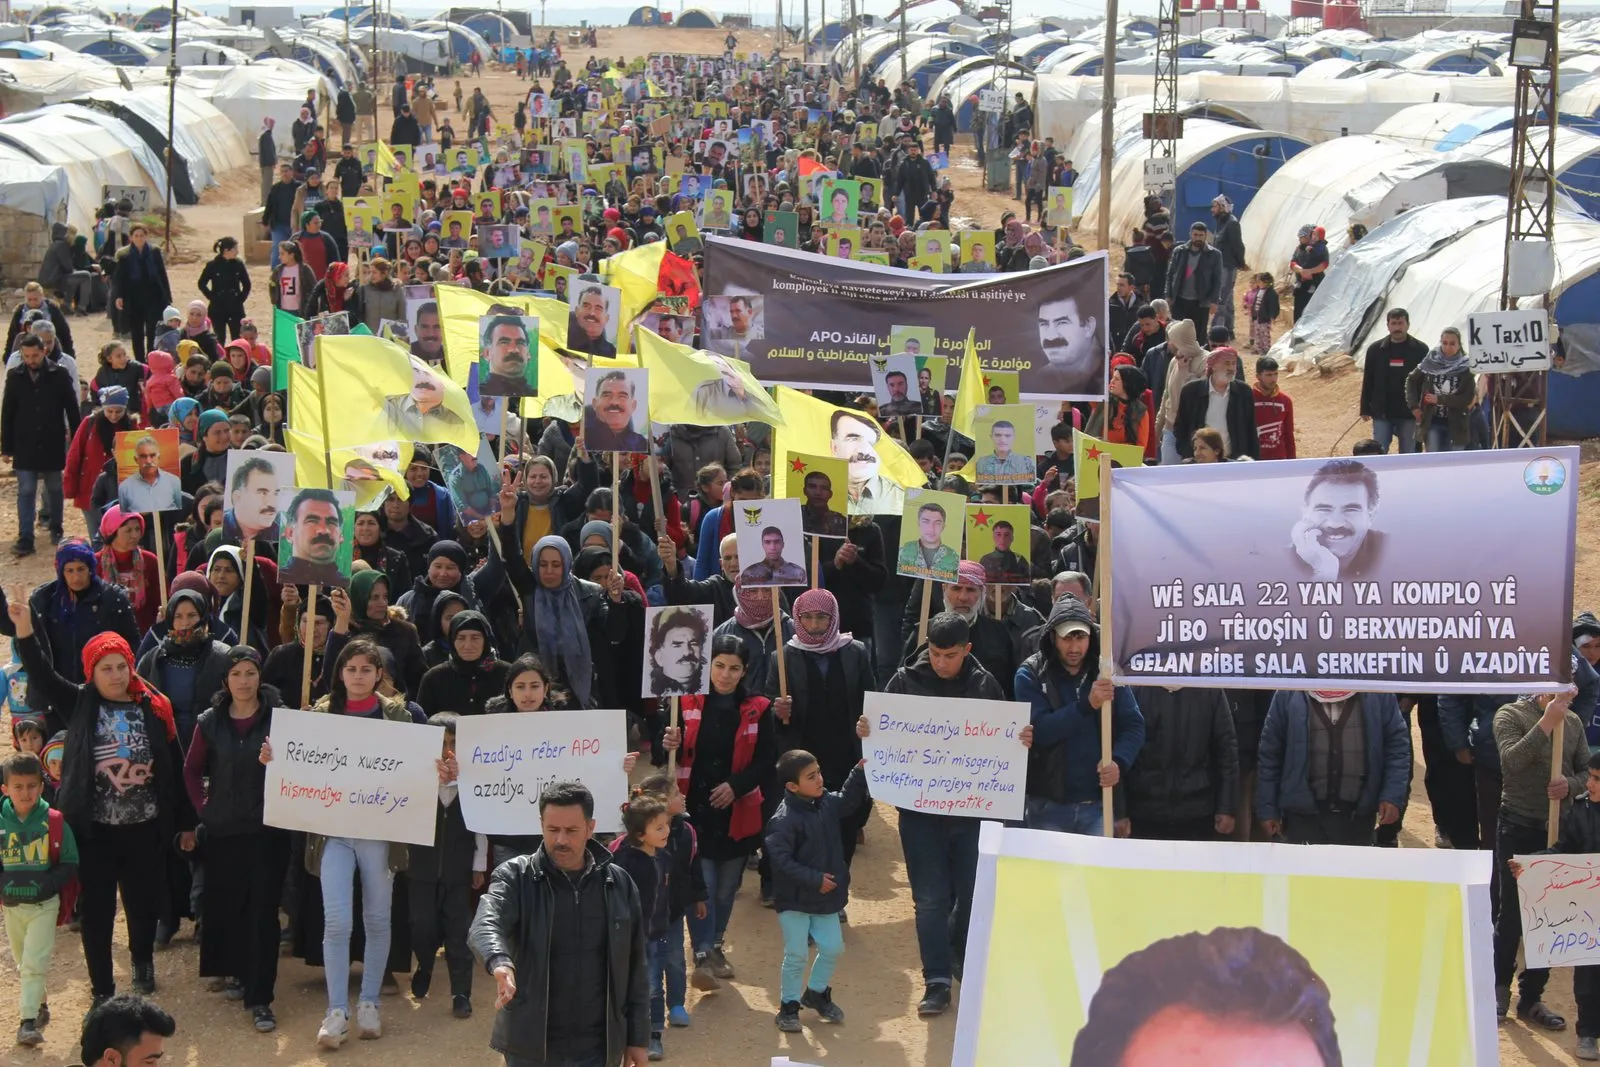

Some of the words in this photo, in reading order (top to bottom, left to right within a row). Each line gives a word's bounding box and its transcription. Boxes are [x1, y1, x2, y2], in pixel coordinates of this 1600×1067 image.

[772, 279, 829, 295] komployek
[1013, 292, 1027, 303] ye
[809, 330, 842, 343] APO
[1469, 318, 1483, 346] k
[767, 347, 805, 360] السلام
[806, 350, 815, 361] و
[1152, 578, 1183, 607] WÊ
[1193, 584, 1244, 606] SALA
[1258, 582, 1288, 605] 22
[1299, 582, 1342, 605] YAN
[1353, 582, 1381, 604] YA
[1392, 582, 1481, 604] KOMPLO
[1491, 576, 1516, 604] YÊ
[1180, 619, 1207, 641] BO
[1220, 611, 1307, 646] TÊKOŞÎN
[1319, 611, 1333, 640] Û
[1344, 611, 1482, 639] BERXWEDANÎ
[1487, 617, 1516, 639] YA
[1130, 653, 1194, 673] GELAN
[1255, 653, 1307, 674] SALA
[1435, 646, 1449, 674] Û
[1460, 646, 1550, 674] AZADÎYÊ
[1005, 721, 1017, 739] û
[358, 755, 403, 772] xweser
[472, 744, 523, 772] Azadîya
[531, 742, 567, 760] rêber
[571, 738, 600, 756] APO
[473, 777, 524, 803] azadîya
[977, 777, 1015, 793] netewa
[385, 795, 409, 814] ye
